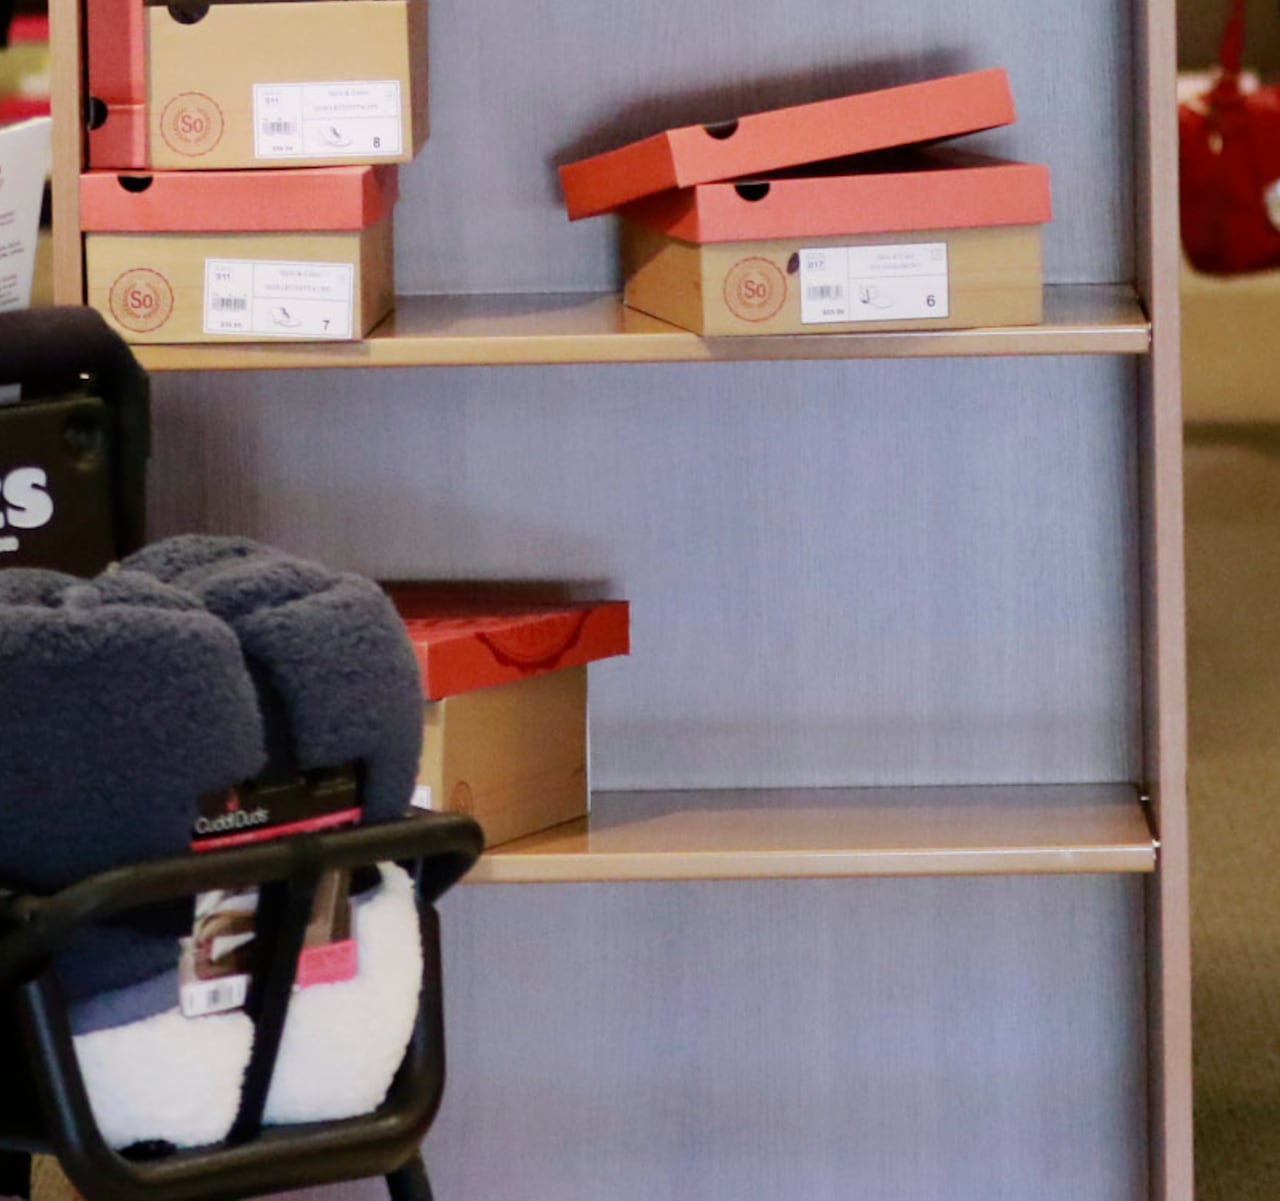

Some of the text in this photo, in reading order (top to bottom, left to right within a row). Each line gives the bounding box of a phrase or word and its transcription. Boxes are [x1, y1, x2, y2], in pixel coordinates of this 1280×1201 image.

[181, 114, 204, 134] So
[373, 136, 381, 148] 8
[744, 279, 766, 299] So
[130, 290, 153, 309] So
[926, 294, 936, 308] 6
[322, 319, 330, 331] 7
